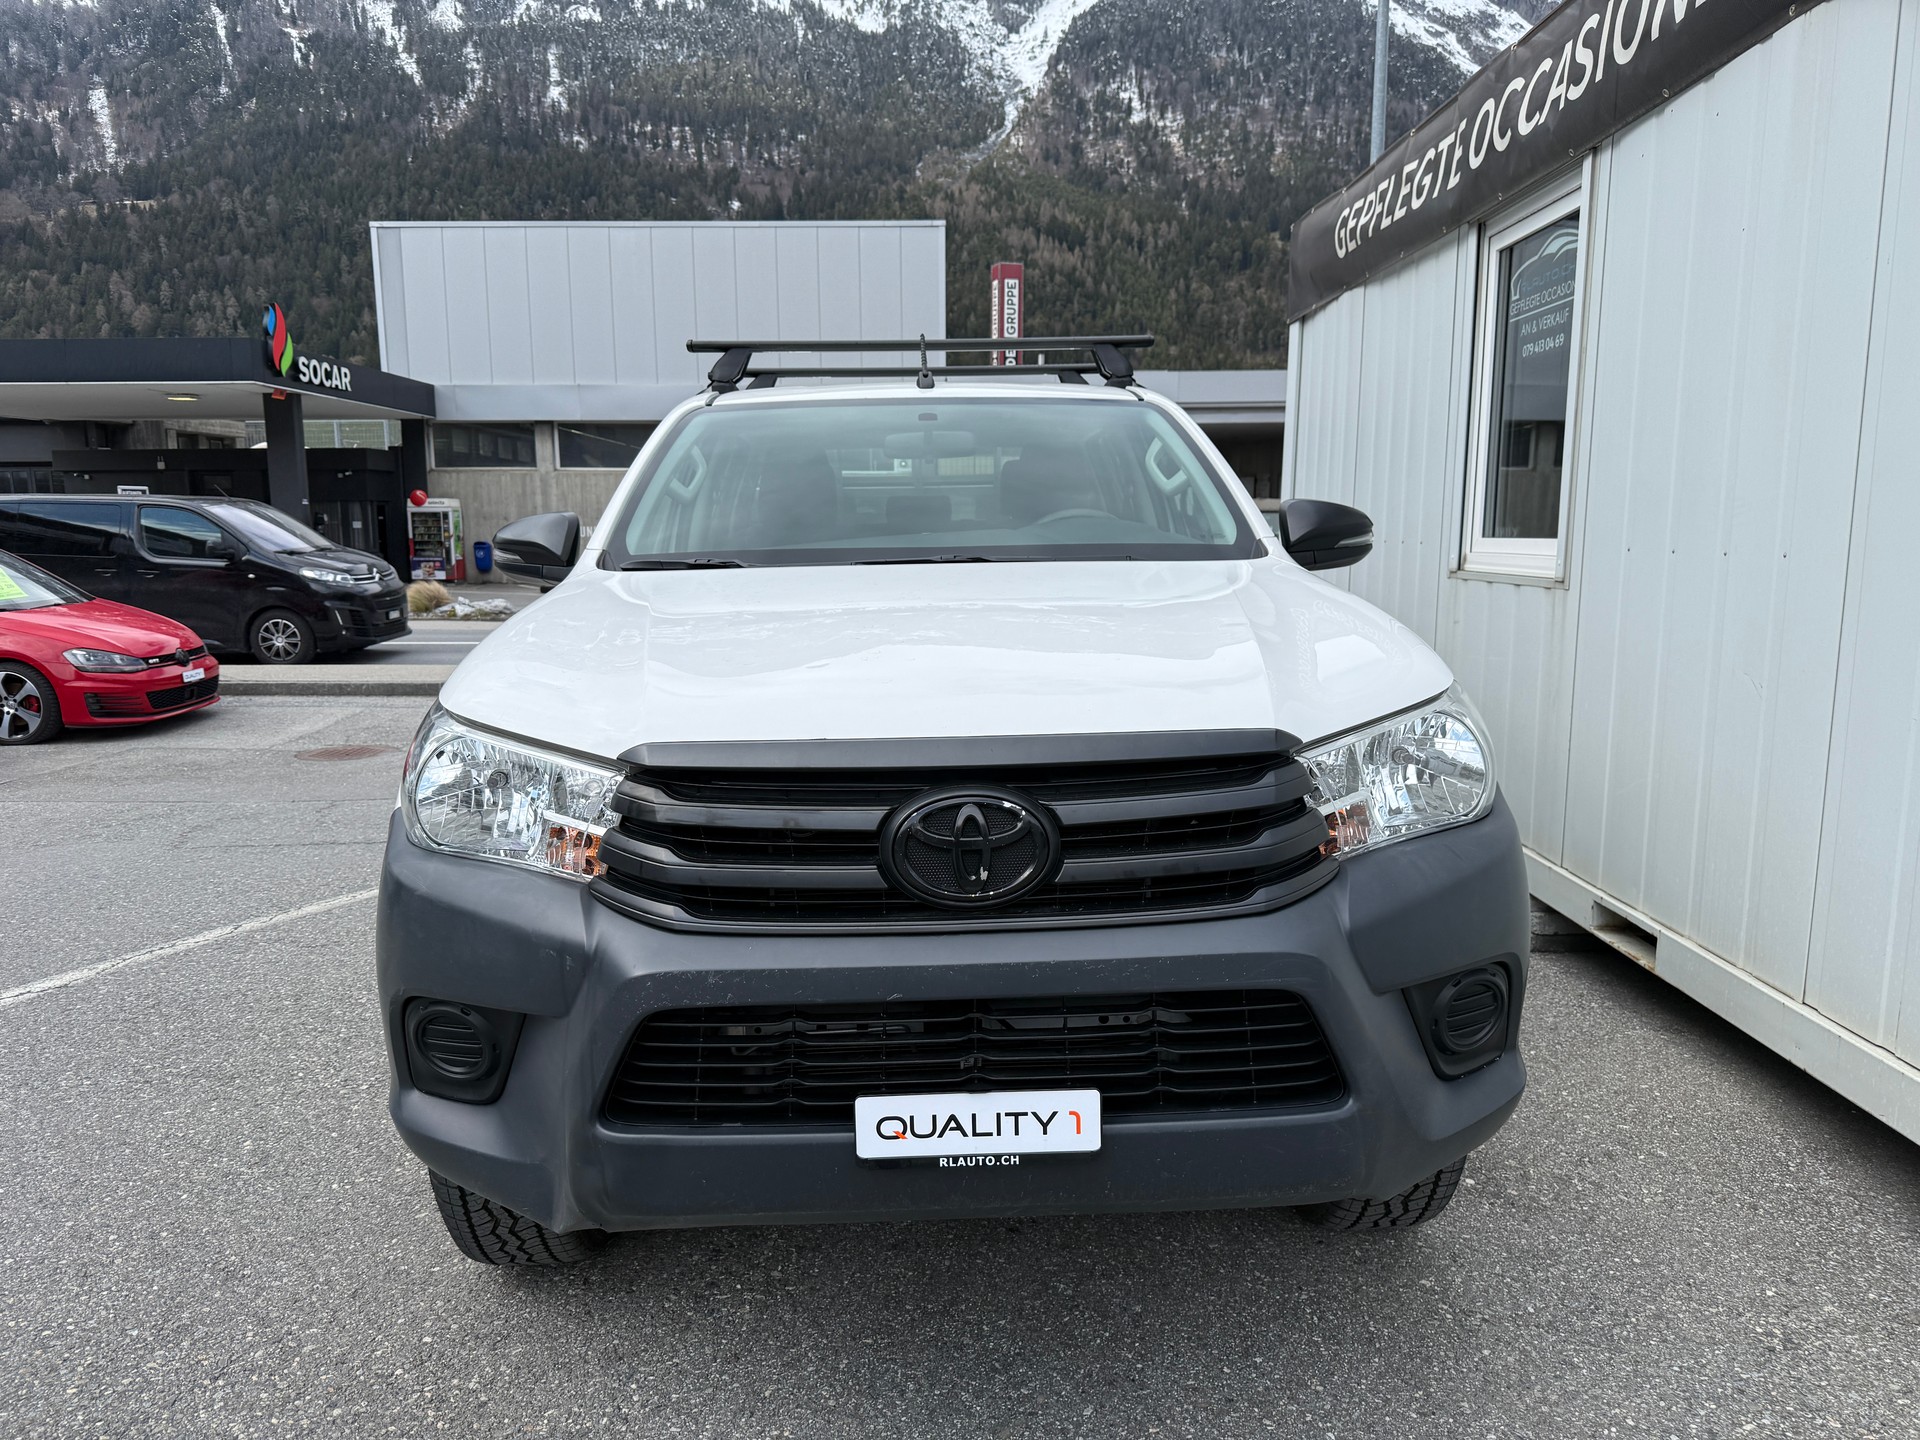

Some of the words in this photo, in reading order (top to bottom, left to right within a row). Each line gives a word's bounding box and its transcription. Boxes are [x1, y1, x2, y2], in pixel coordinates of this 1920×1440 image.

[1334, 117, 1467, 259] GEPFLEGTE
[1006, 281, 1017, 335] GRUPPE
[1510, 292, 1541, 315] GEPFLEGTE
[1520, 321, 1531, 337] AN
[1531, 320, 1537, 333] &
[1538, 307, 1570, 330] VERKAUF
[1522, 342, 1534, 357] 079
[1534, 339, 1545, 353] 413
[1545, 336, 1555, 351] 04
[1555, 333, 1565, 348] 69
[298, 355, 352, 392] SOCAR
[876, 1111, 1059, 1140] QUALITY
[1068, 1110, 1082, 1135] 1
[939, 1155, 1020, 1167] RLAUTO.CH
